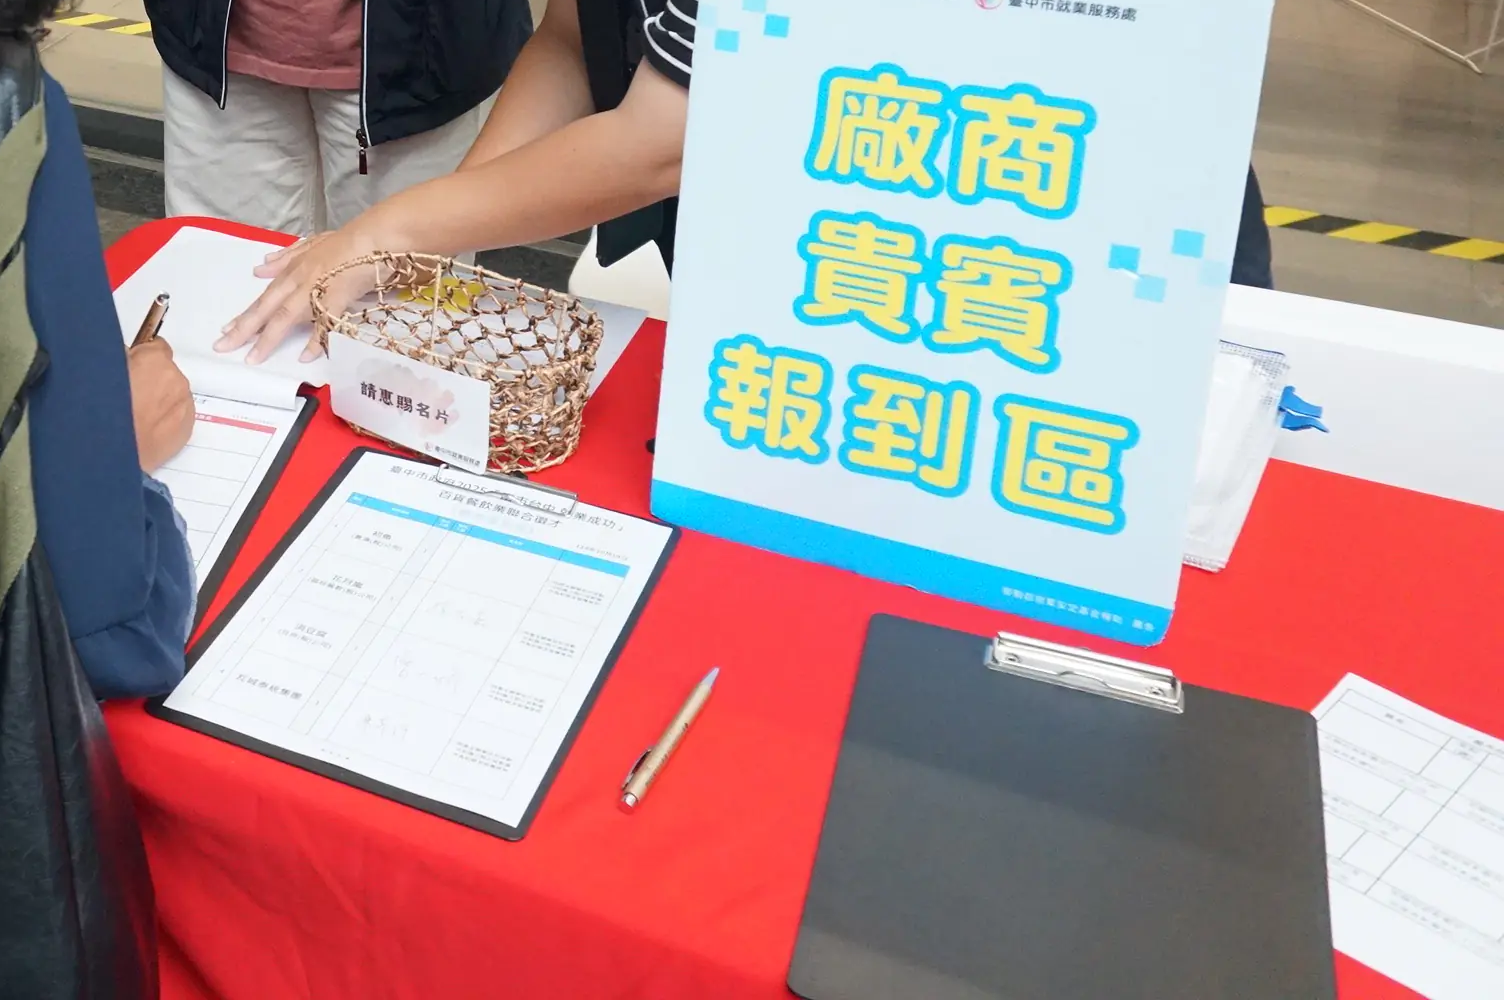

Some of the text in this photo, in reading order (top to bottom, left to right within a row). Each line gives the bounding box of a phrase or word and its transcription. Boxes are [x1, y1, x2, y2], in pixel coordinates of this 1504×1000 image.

[807, 65, 1094, 218] 廠商
[795, 214, 1072, 372] 貴賓
[360, 381, 449, 424] 請惠賜名片
[706, 336, 1137, 534] 報到區
